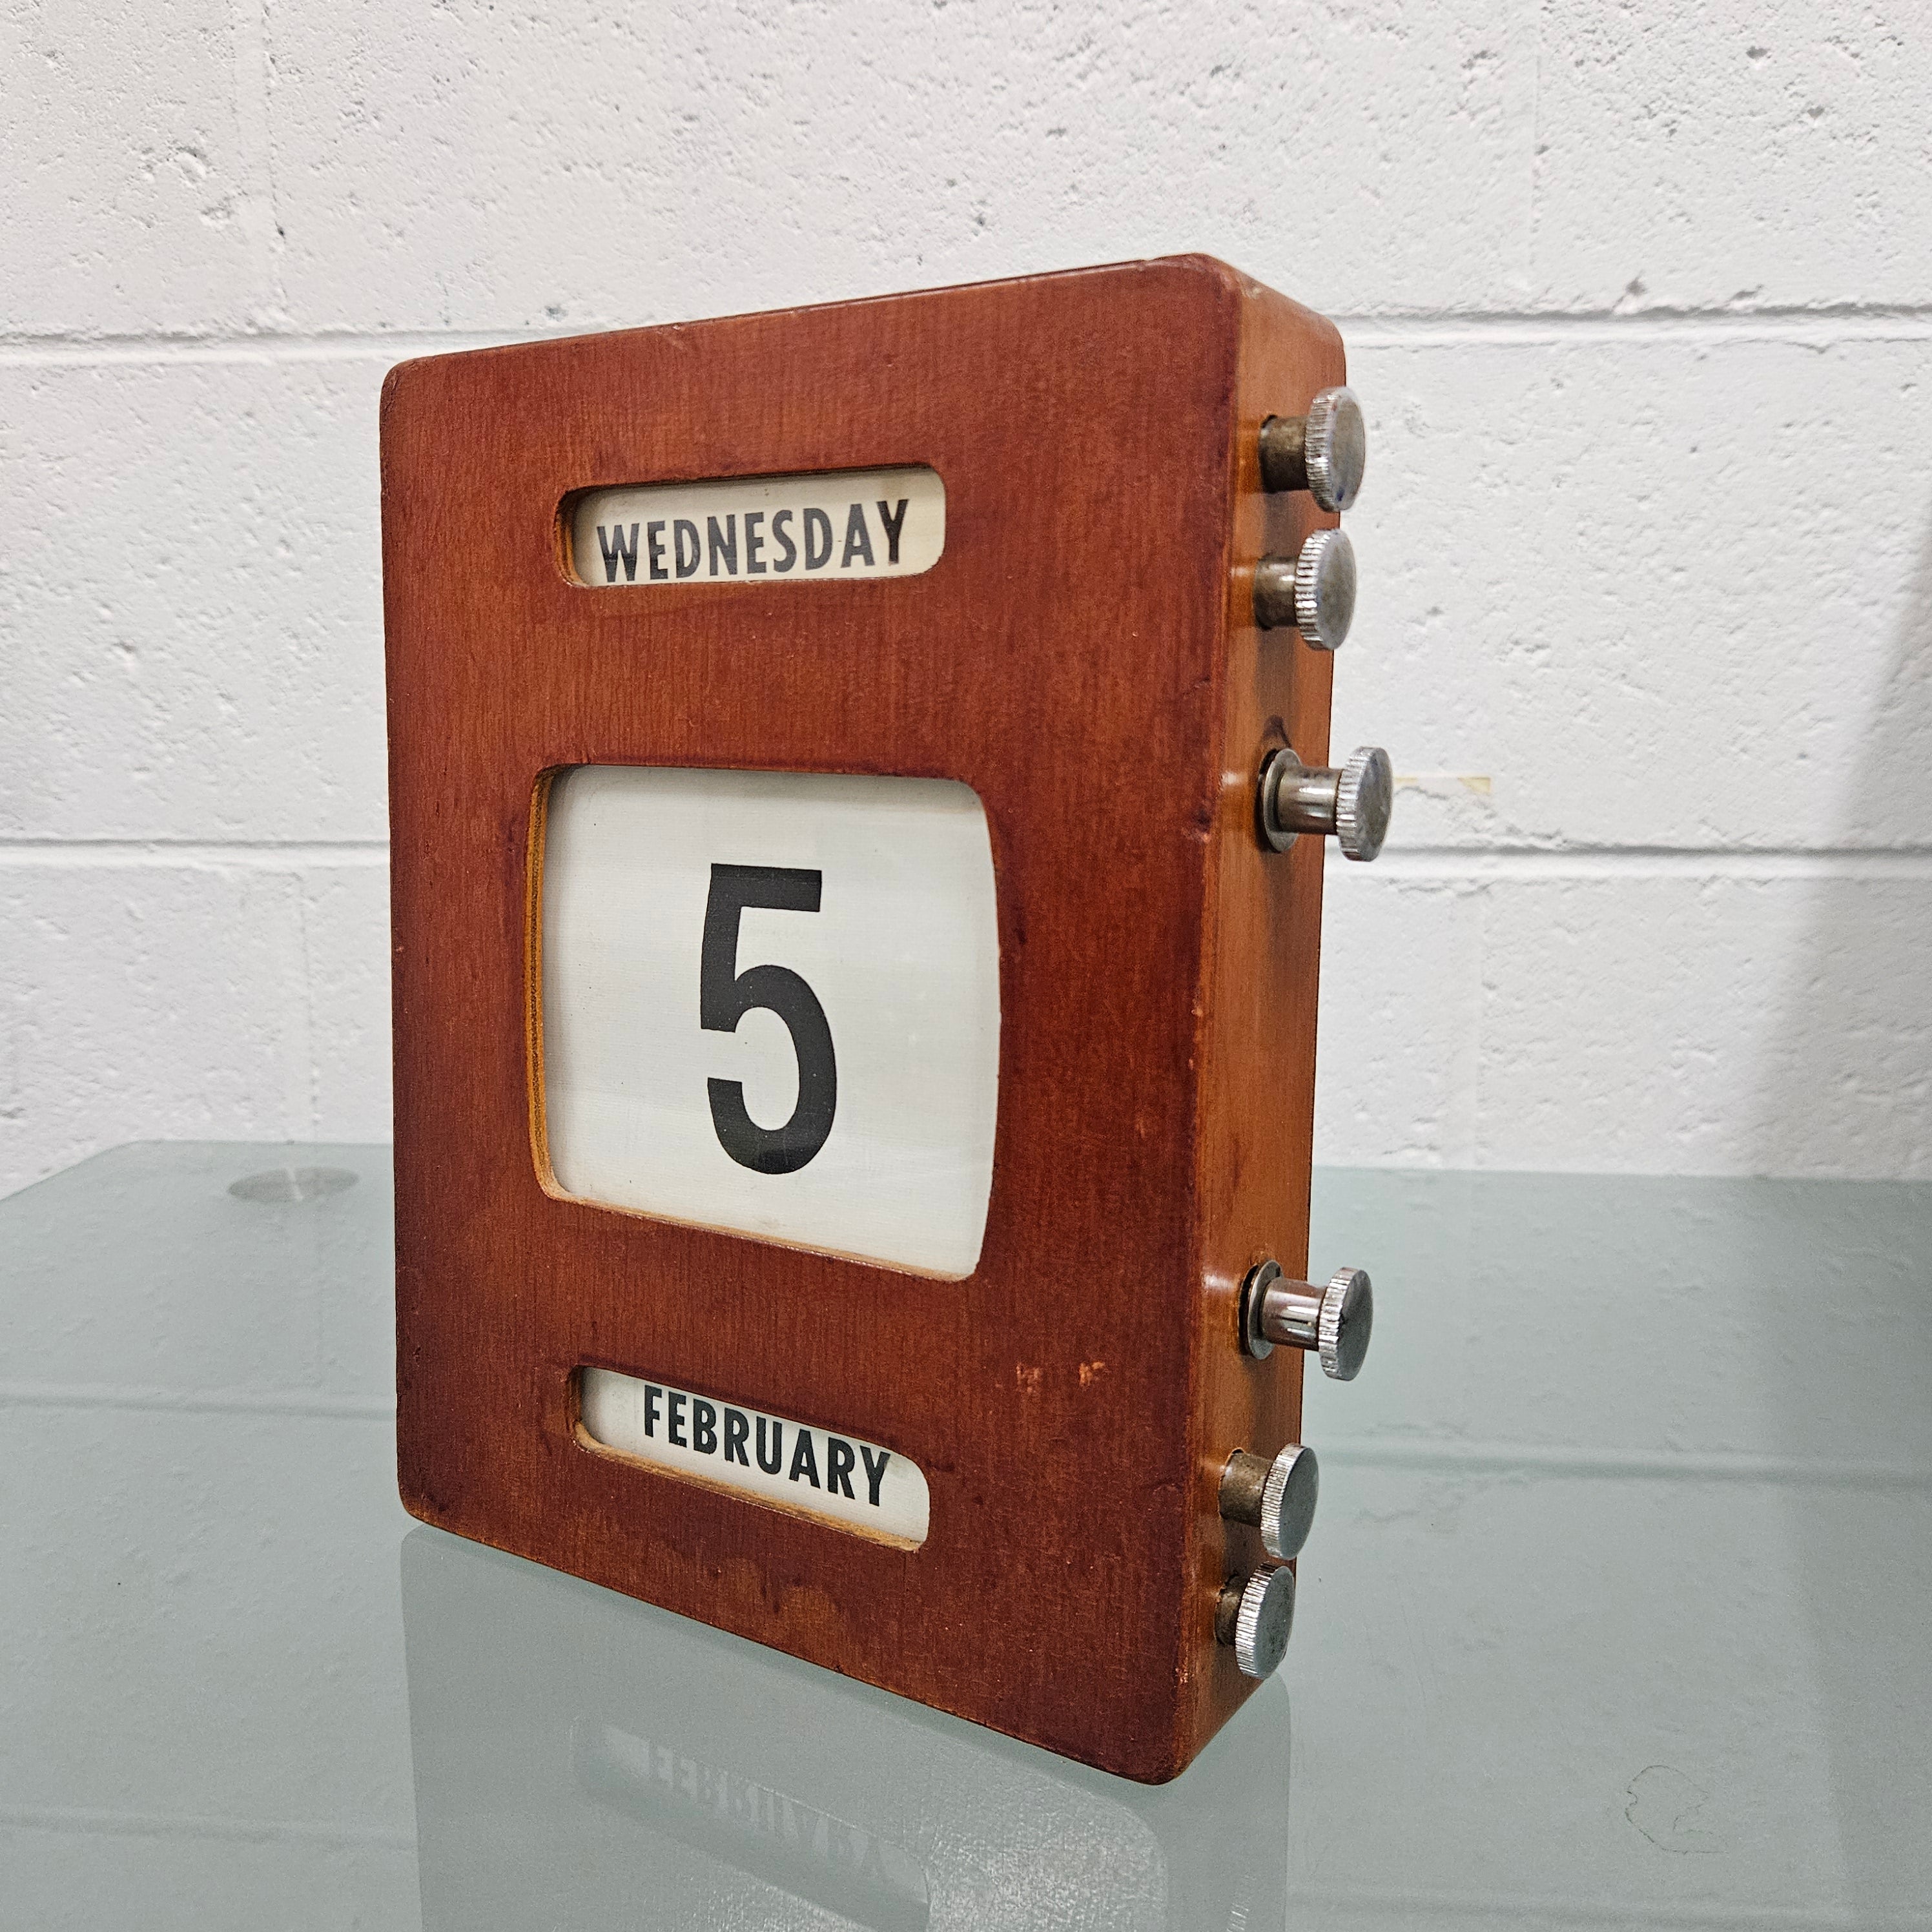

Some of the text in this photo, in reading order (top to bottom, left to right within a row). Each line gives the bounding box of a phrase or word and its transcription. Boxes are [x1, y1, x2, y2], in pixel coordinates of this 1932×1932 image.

[597, 498, 909, 583] WEDNESDAY
[700, 863, 838, 1175] 5
[644, 1384, 891, 1507] FEBRUARY
